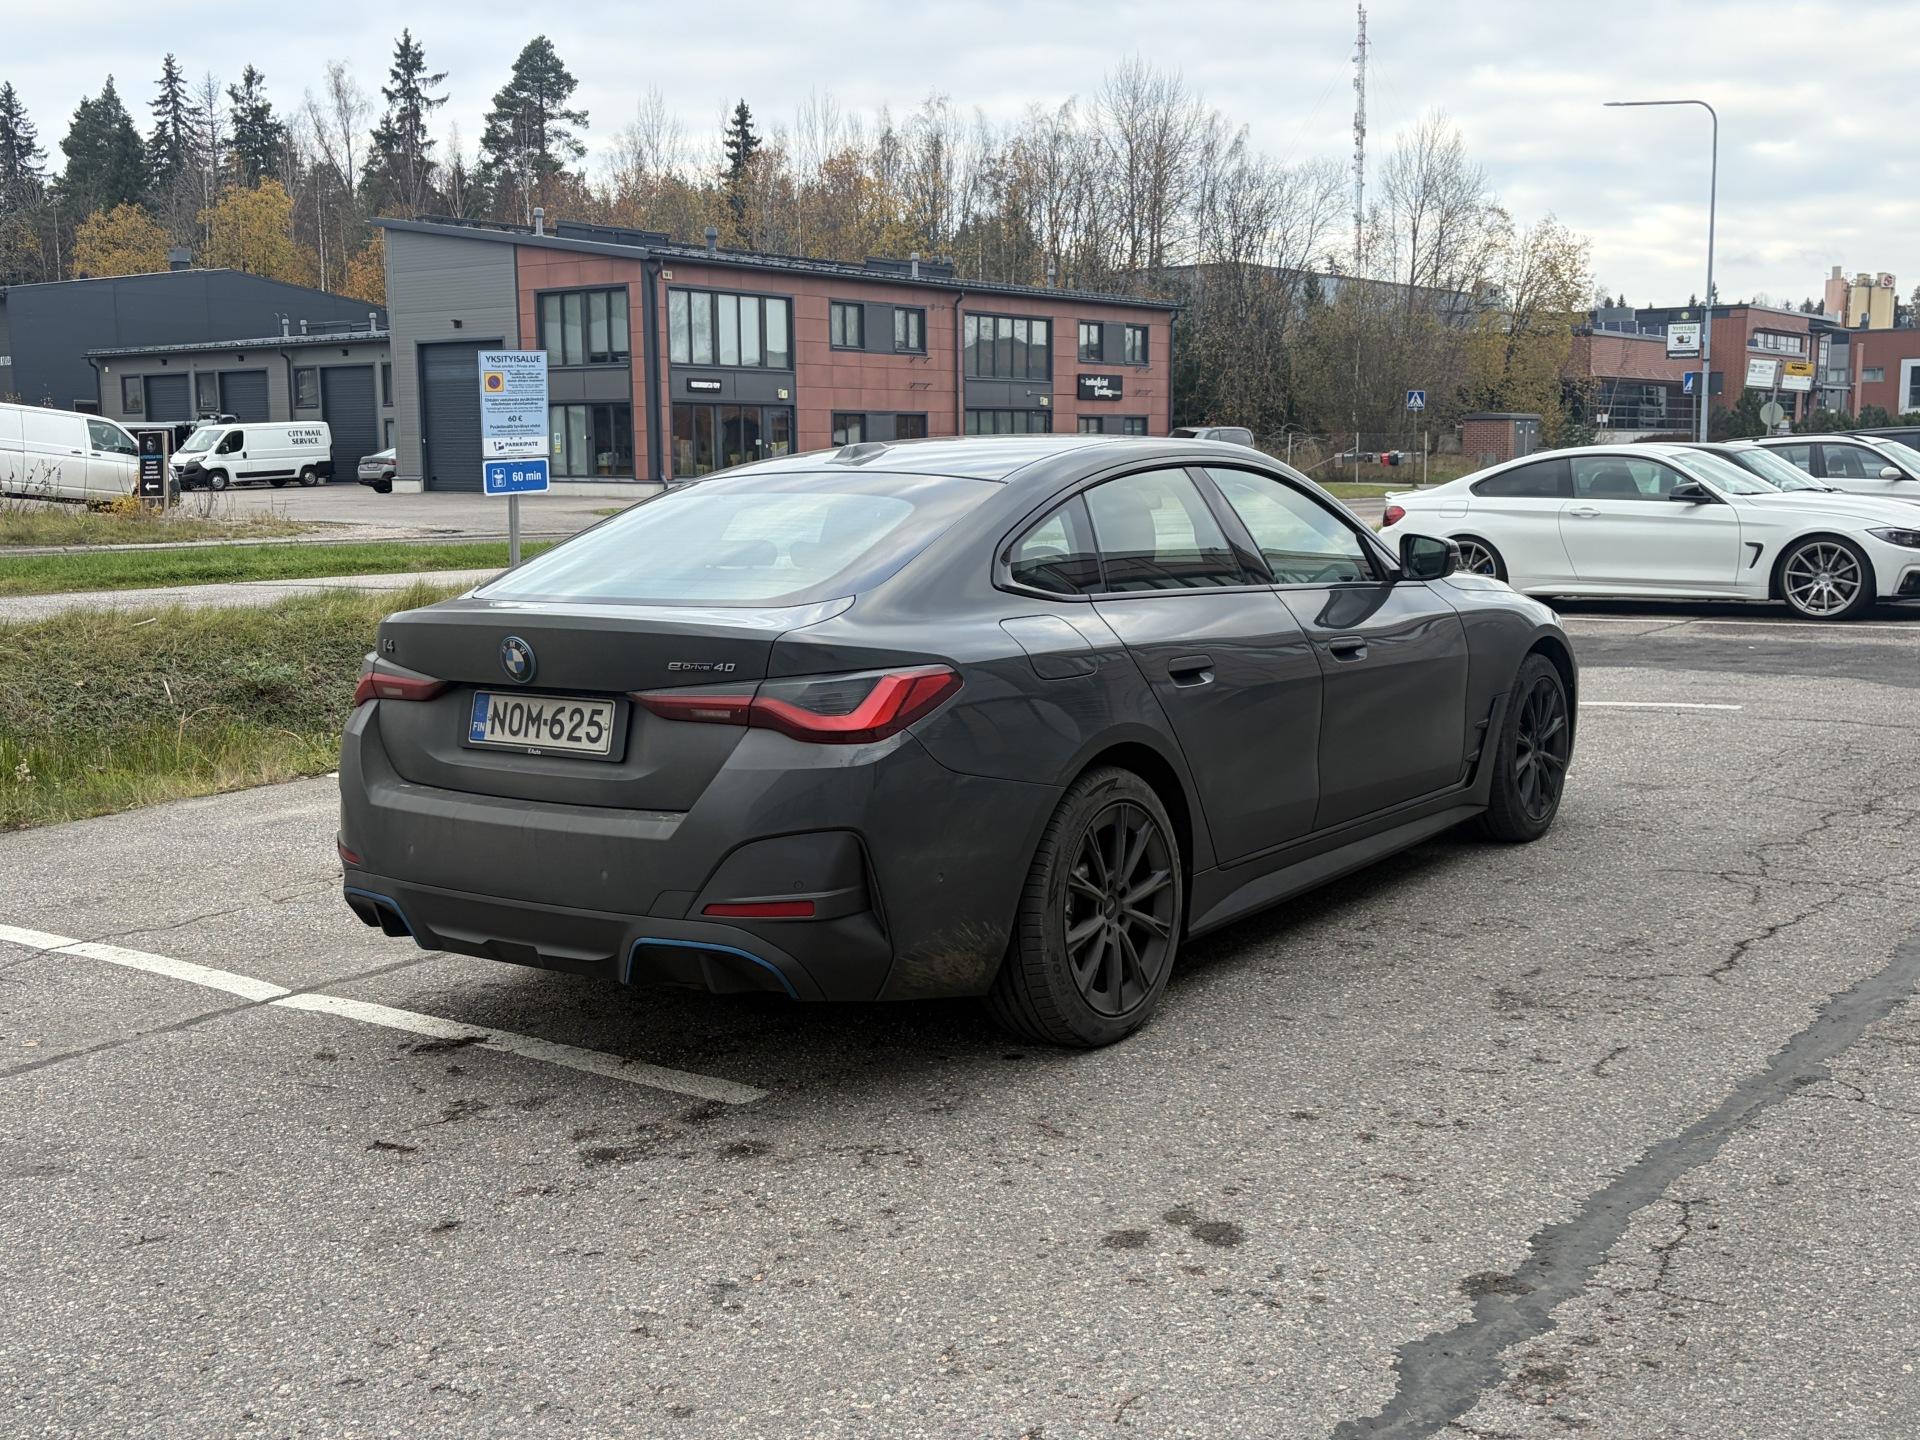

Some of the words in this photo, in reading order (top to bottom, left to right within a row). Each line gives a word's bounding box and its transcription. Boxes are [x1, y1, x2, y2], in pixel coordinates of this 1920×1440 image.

[485, 355, 542, 363] YKSITYISALUE
[512, 471, 524, 482] 60
[526, 470, 541, 480] min
[473, 721, 485, 732] FIN
[490, 701, 603, 744] NOM-625
